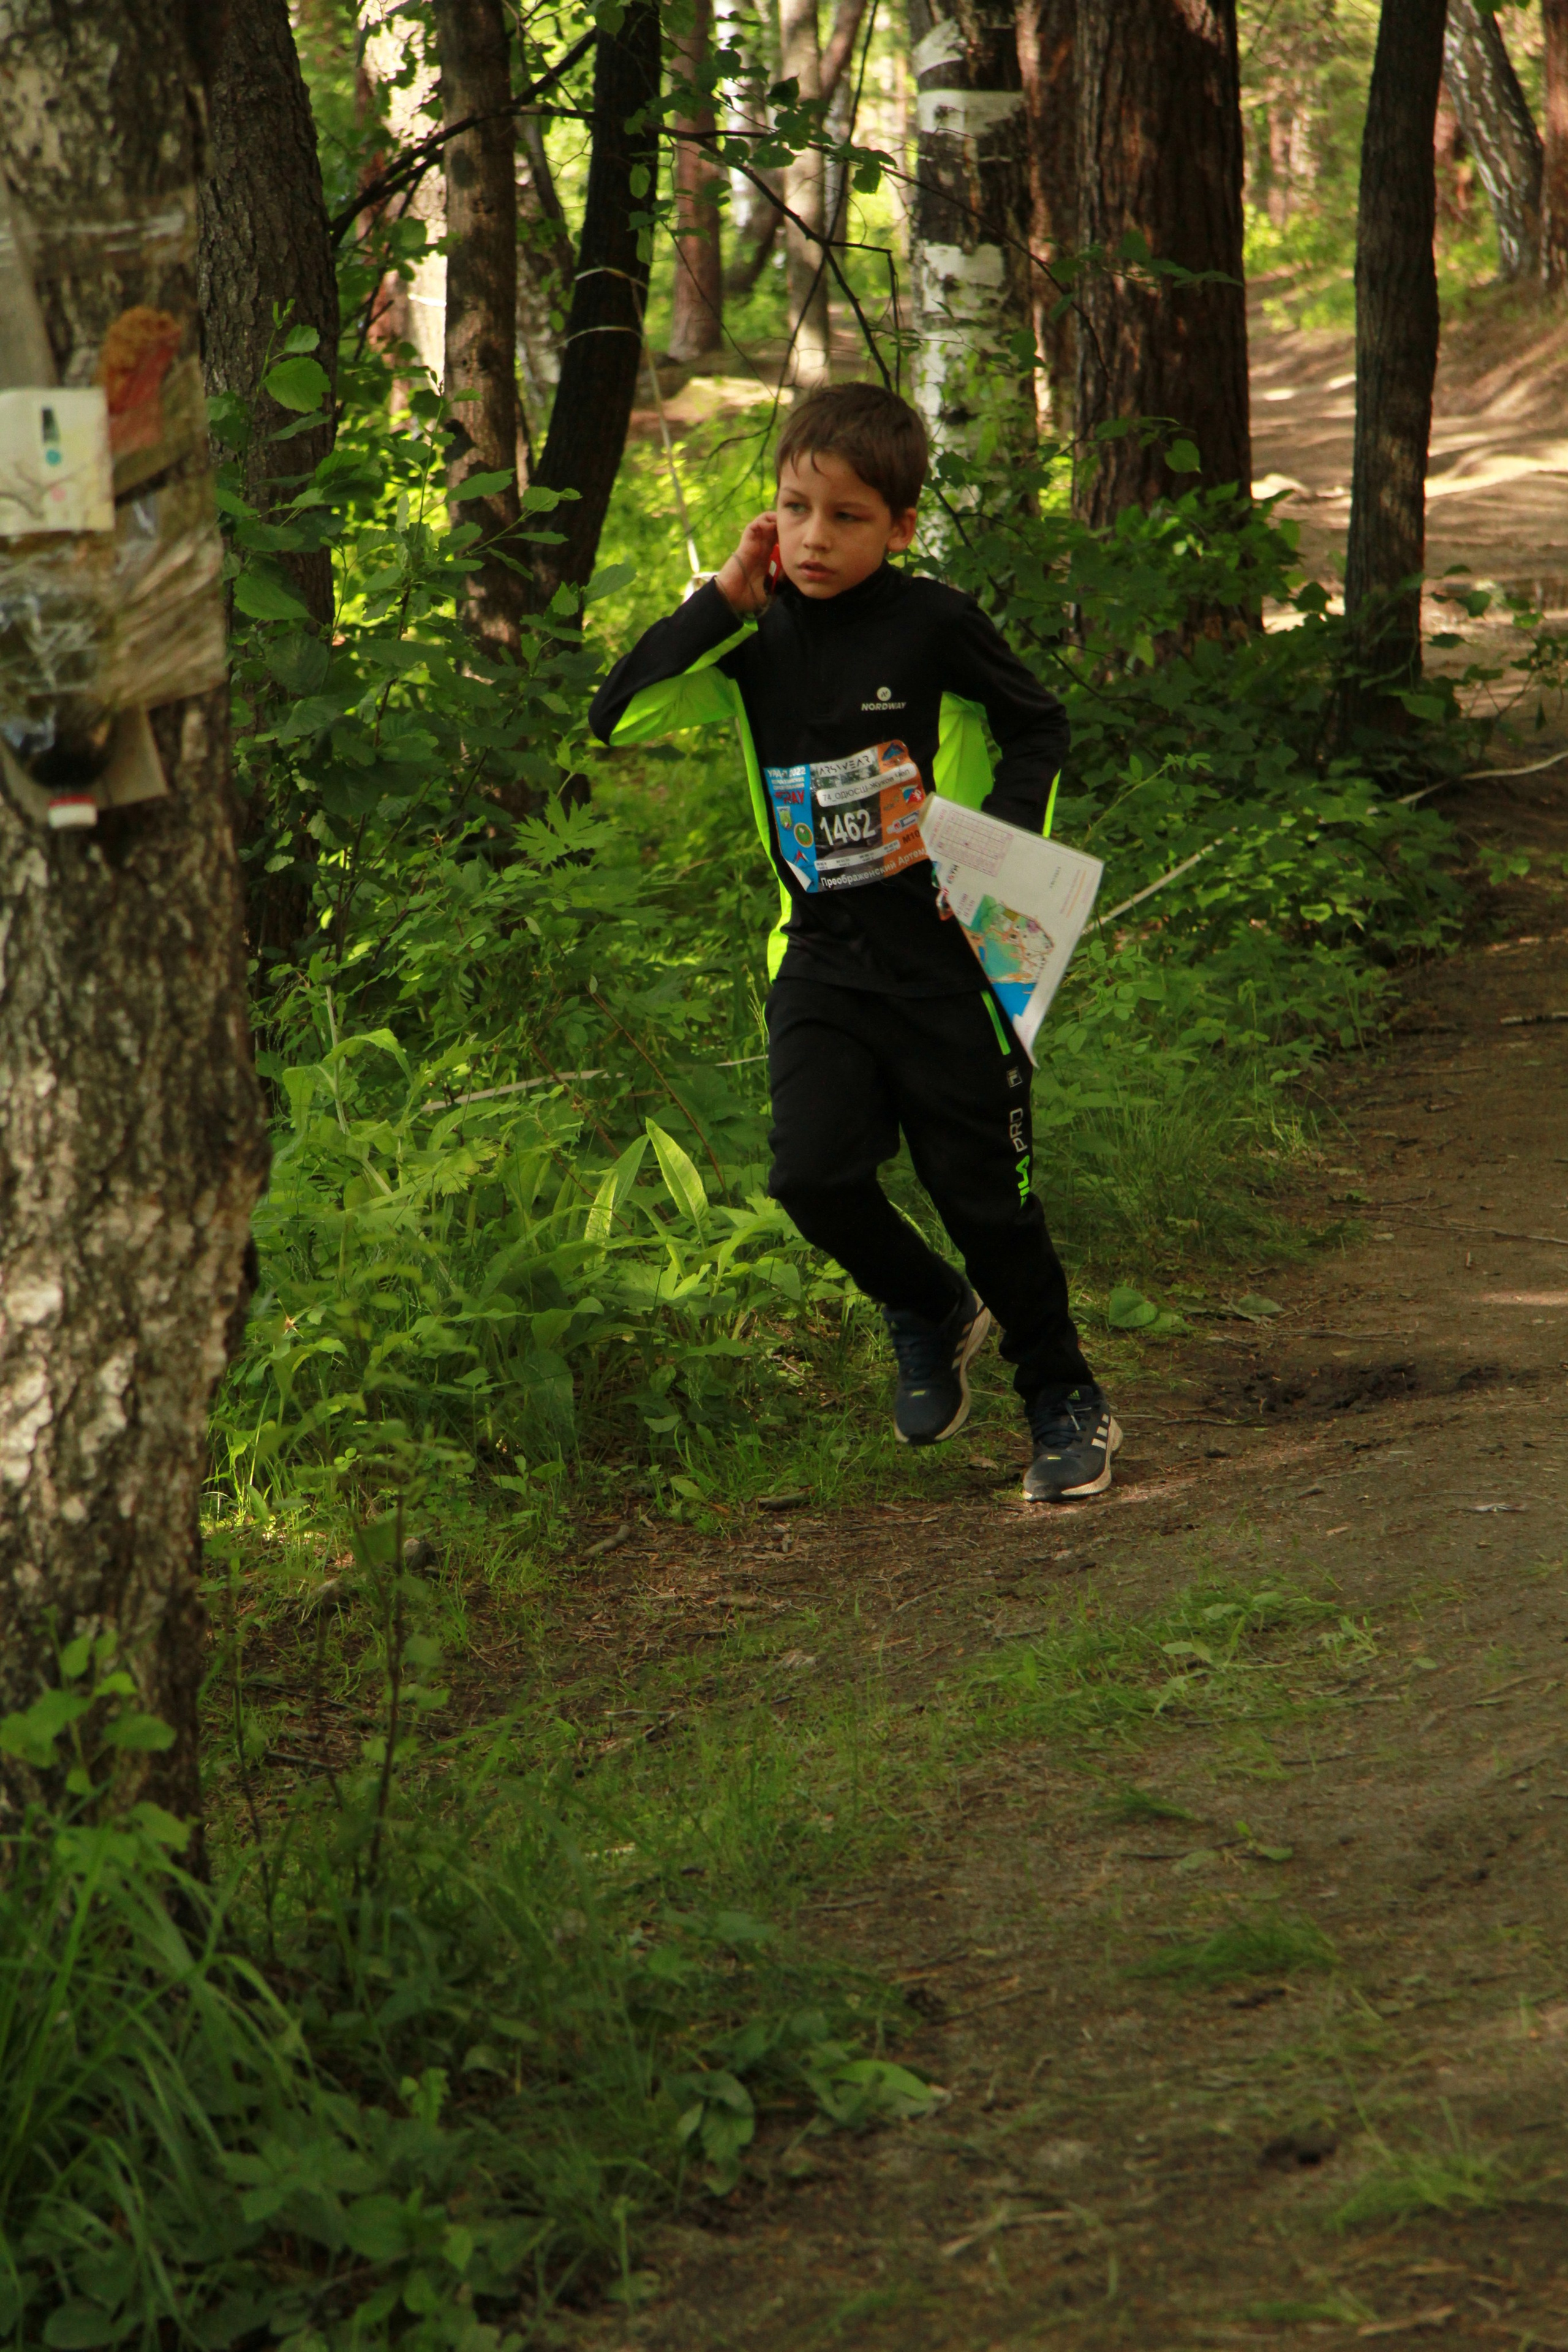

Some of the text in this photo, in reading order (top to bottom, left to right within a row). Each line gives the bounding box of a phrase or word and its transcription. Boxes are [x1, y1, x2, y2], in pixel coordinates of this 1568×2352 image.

[861, 703, 907, 711] NORDWAY
[820, 809, 876, 846] 1462
[820, 860, 897, 888] Преображенский
